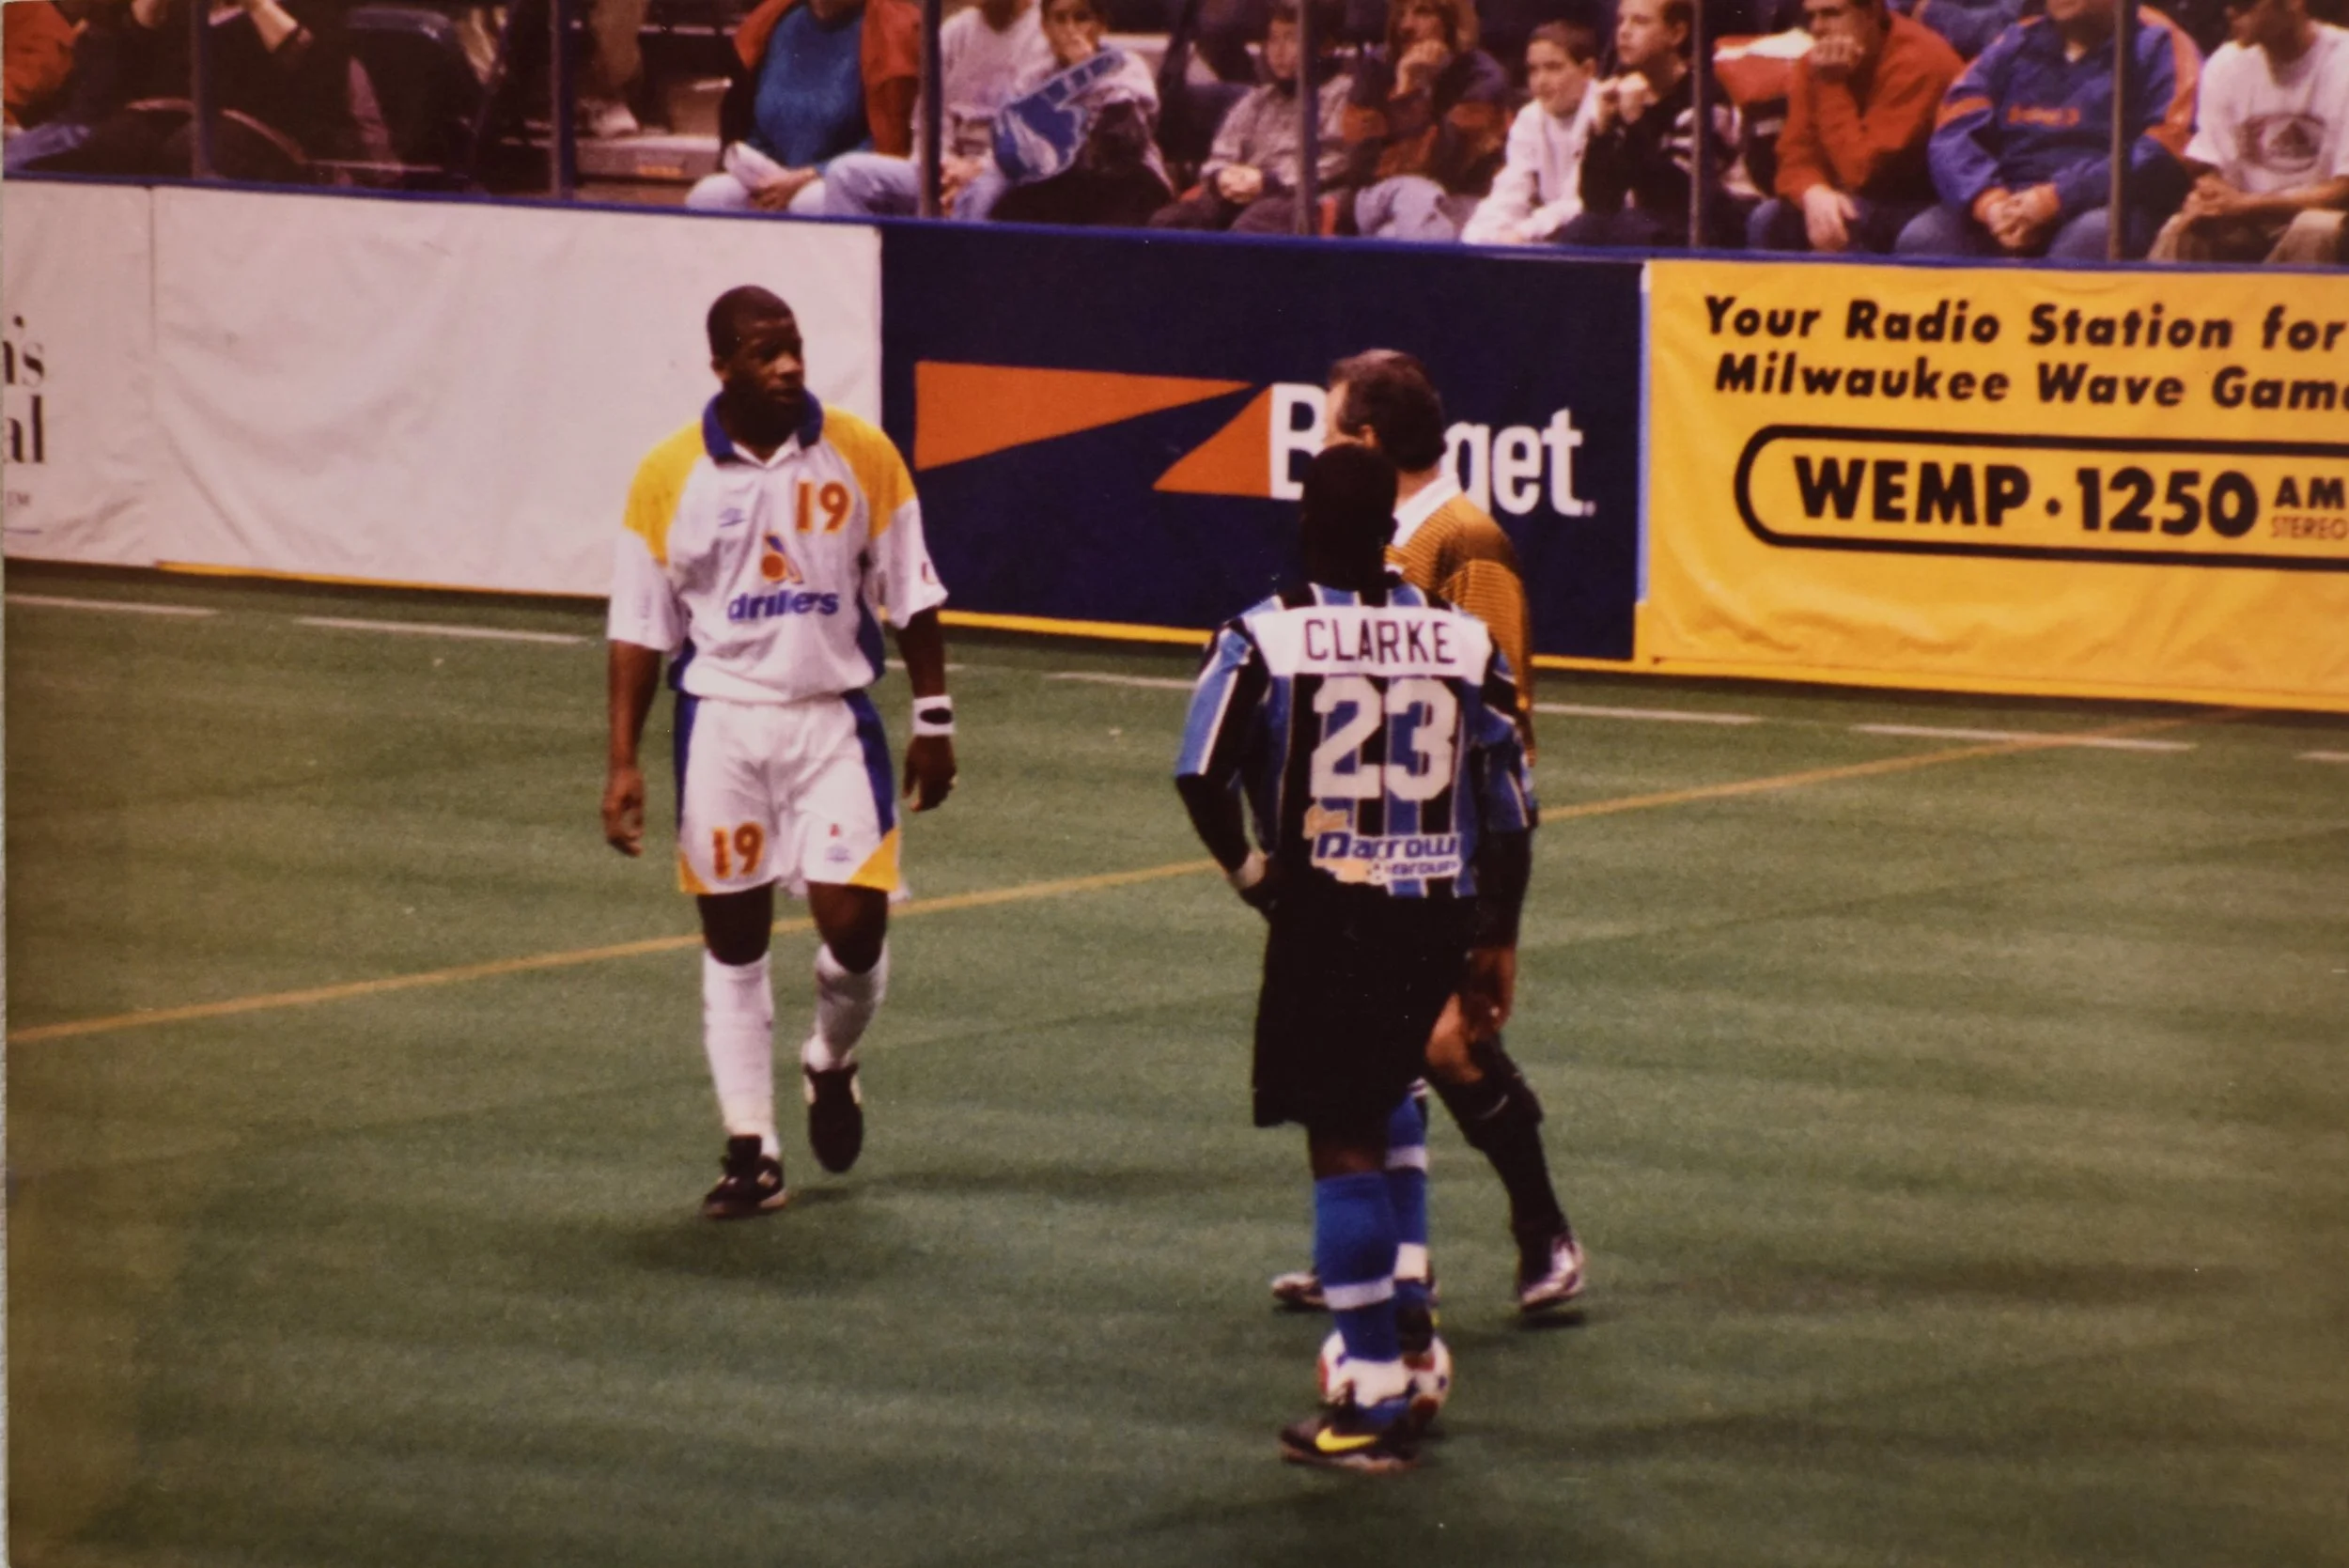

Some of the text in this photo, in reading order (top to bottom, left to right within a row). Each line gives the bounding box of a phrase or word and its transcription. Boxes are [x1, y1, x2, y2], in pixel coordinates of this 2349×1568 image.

[1704, 296, 2348, 352] Your Radio Station for
[1714, 350, 2349, 411] Milwaukee Wave Gam
[1269, 381, 1585, 518] Bget
[795, 479, 851, 535] 19
[1793, 456, 2346, 537] WEMP 1250 AM
[2270, 516, 2349, 540] STEREO
[1304, 618, 1457, 665] CLARKE
[1310, 676, 1457, 800] 23
[711, 821, 765, 879] 19
